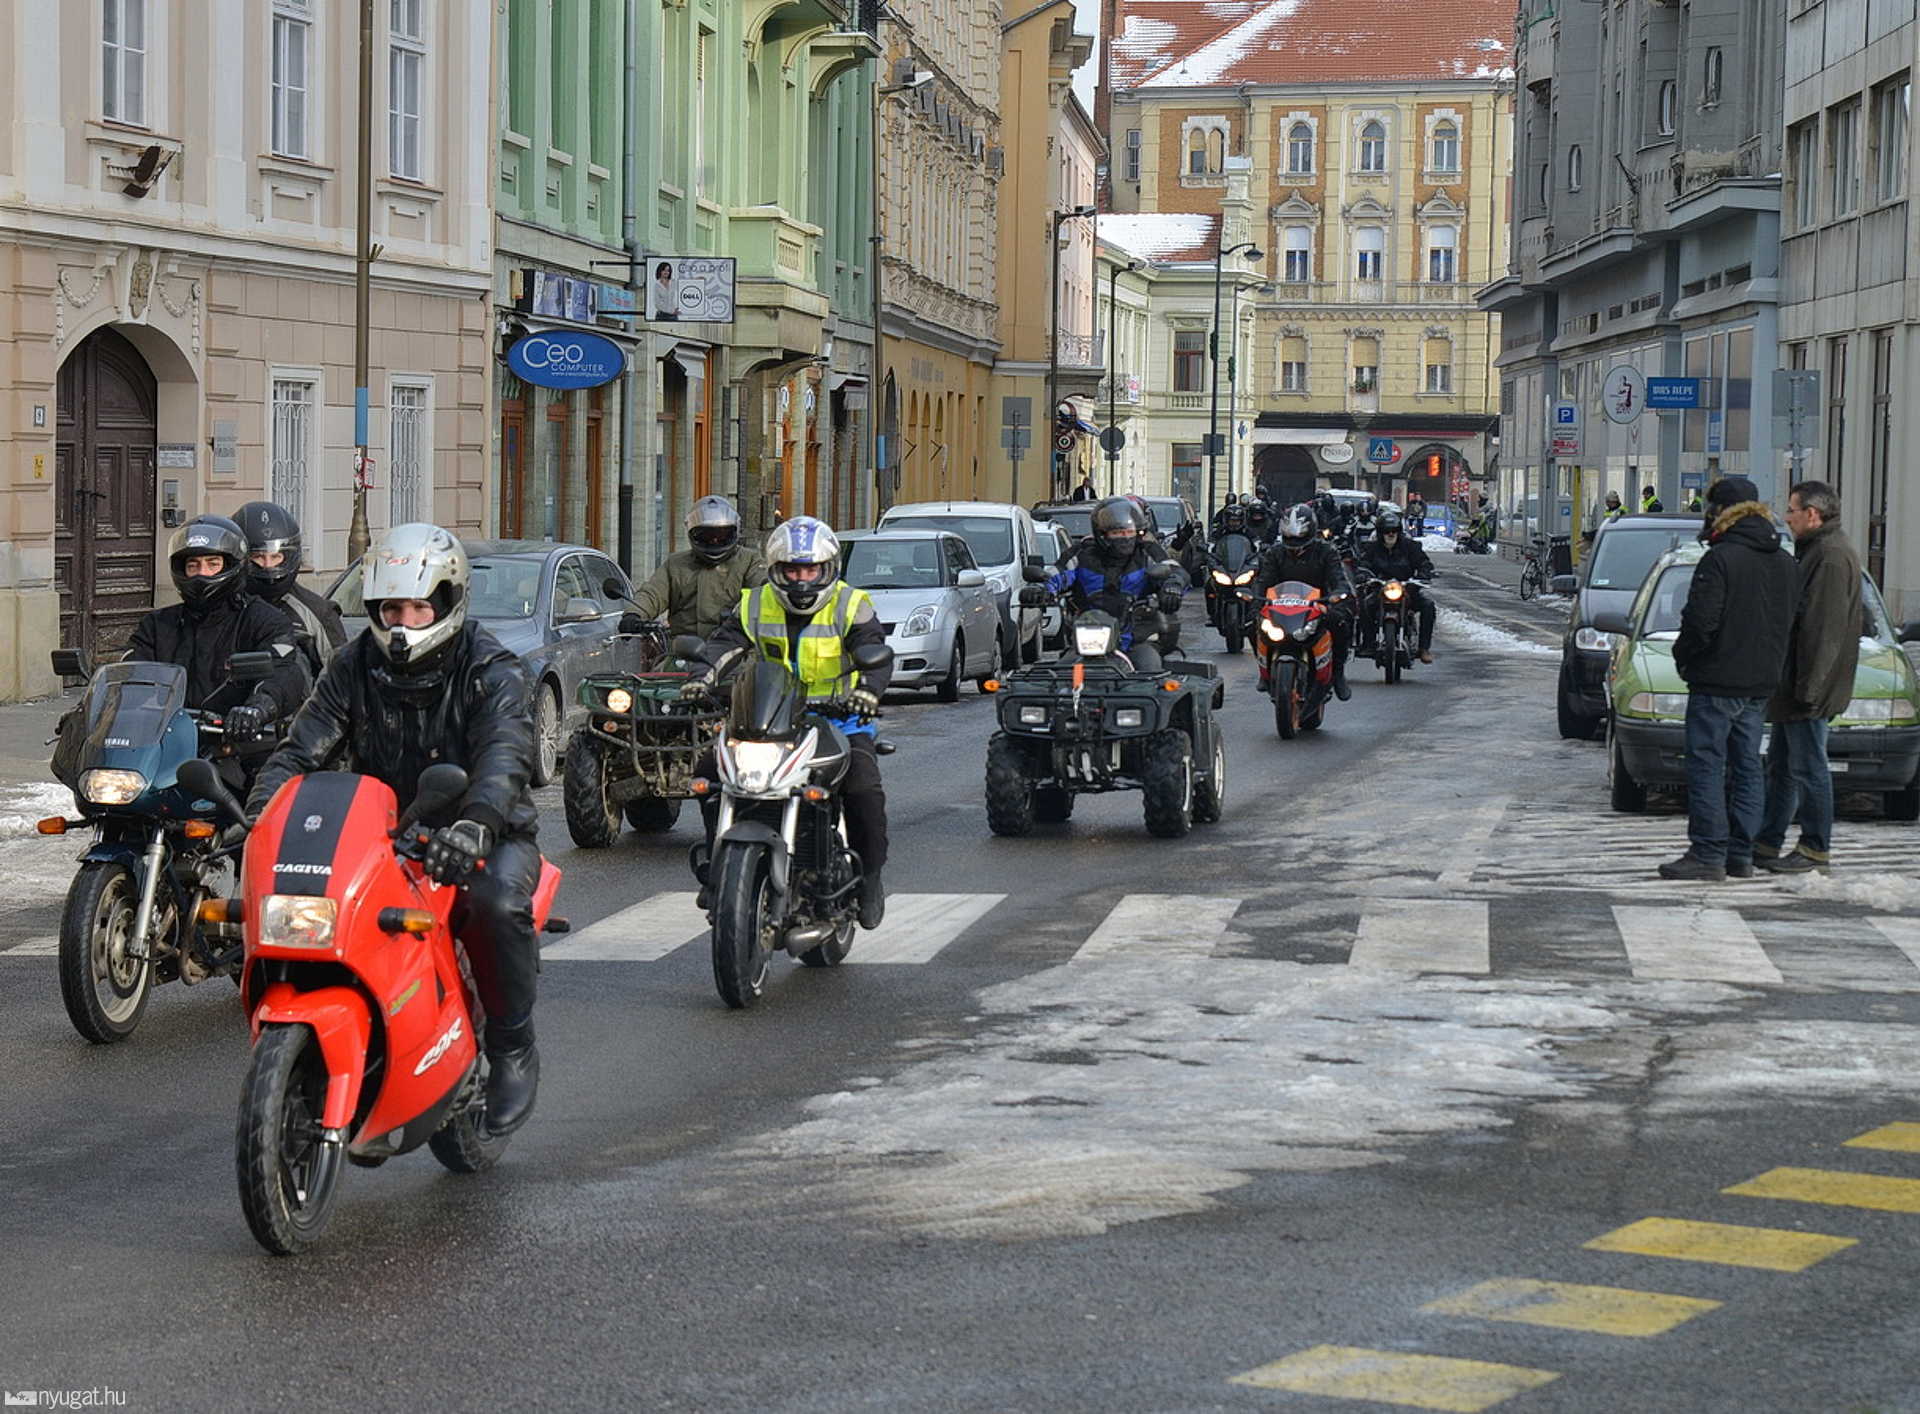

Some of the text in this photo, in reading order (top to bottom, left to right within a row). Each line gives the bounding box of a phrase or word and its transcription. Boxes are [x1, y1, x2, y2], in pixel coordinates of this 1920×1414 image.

[523, 338, 584, 368] Ceo
[551, 363, 604, 372] COMPUTER
[1560, 409, 1571, 422] P
[272, 863, 333, 876] CAGIVA
